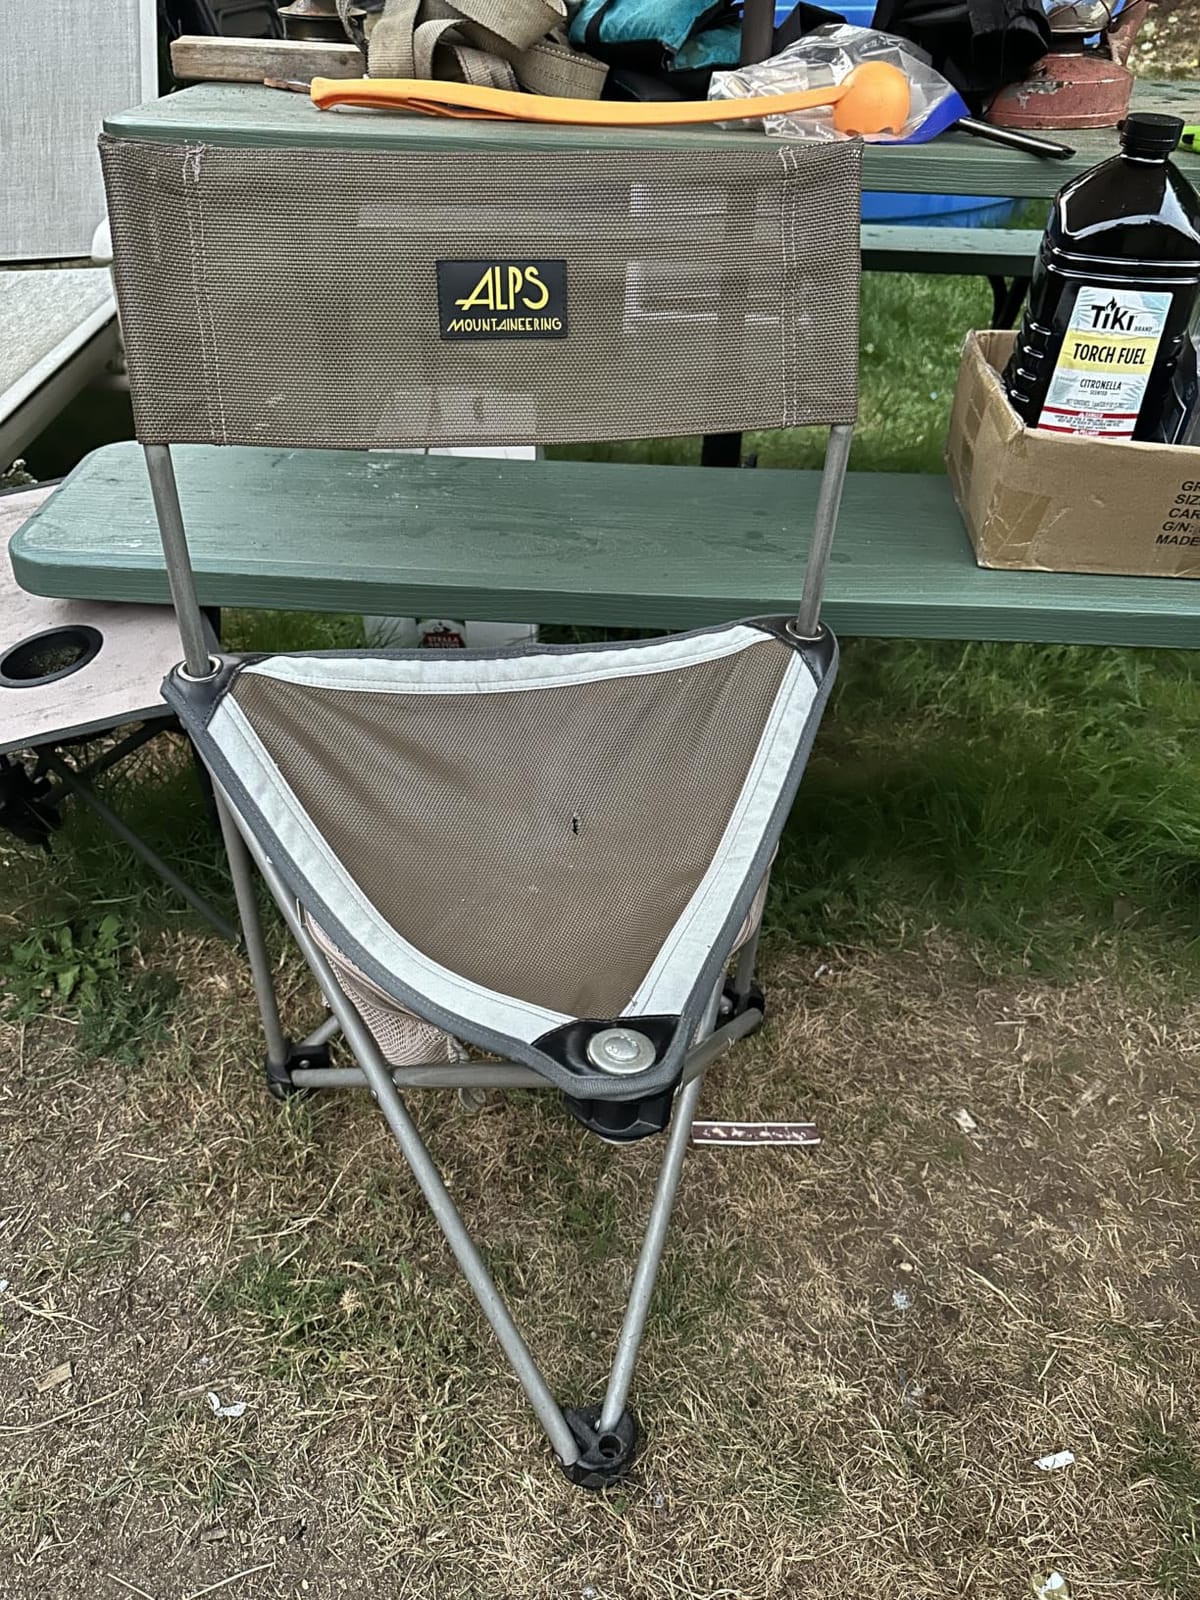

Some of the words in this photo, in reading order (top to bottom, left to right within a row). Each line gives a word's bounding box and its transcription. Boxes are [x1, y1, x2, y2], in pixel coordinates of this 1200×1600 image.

[454, 266, 549, 310] ALPS
[447, 317, 562, 332] MOUNTAINEERING
[1073, 343, 1116, 363] TORCH
[1117, 347, 1146, 365] FUEL
[1080, 378, 1122, 390] CITRONELLA
[1162, 521, 1194, 533] G/N:
[1155, 534, 1200, 546] MADE
